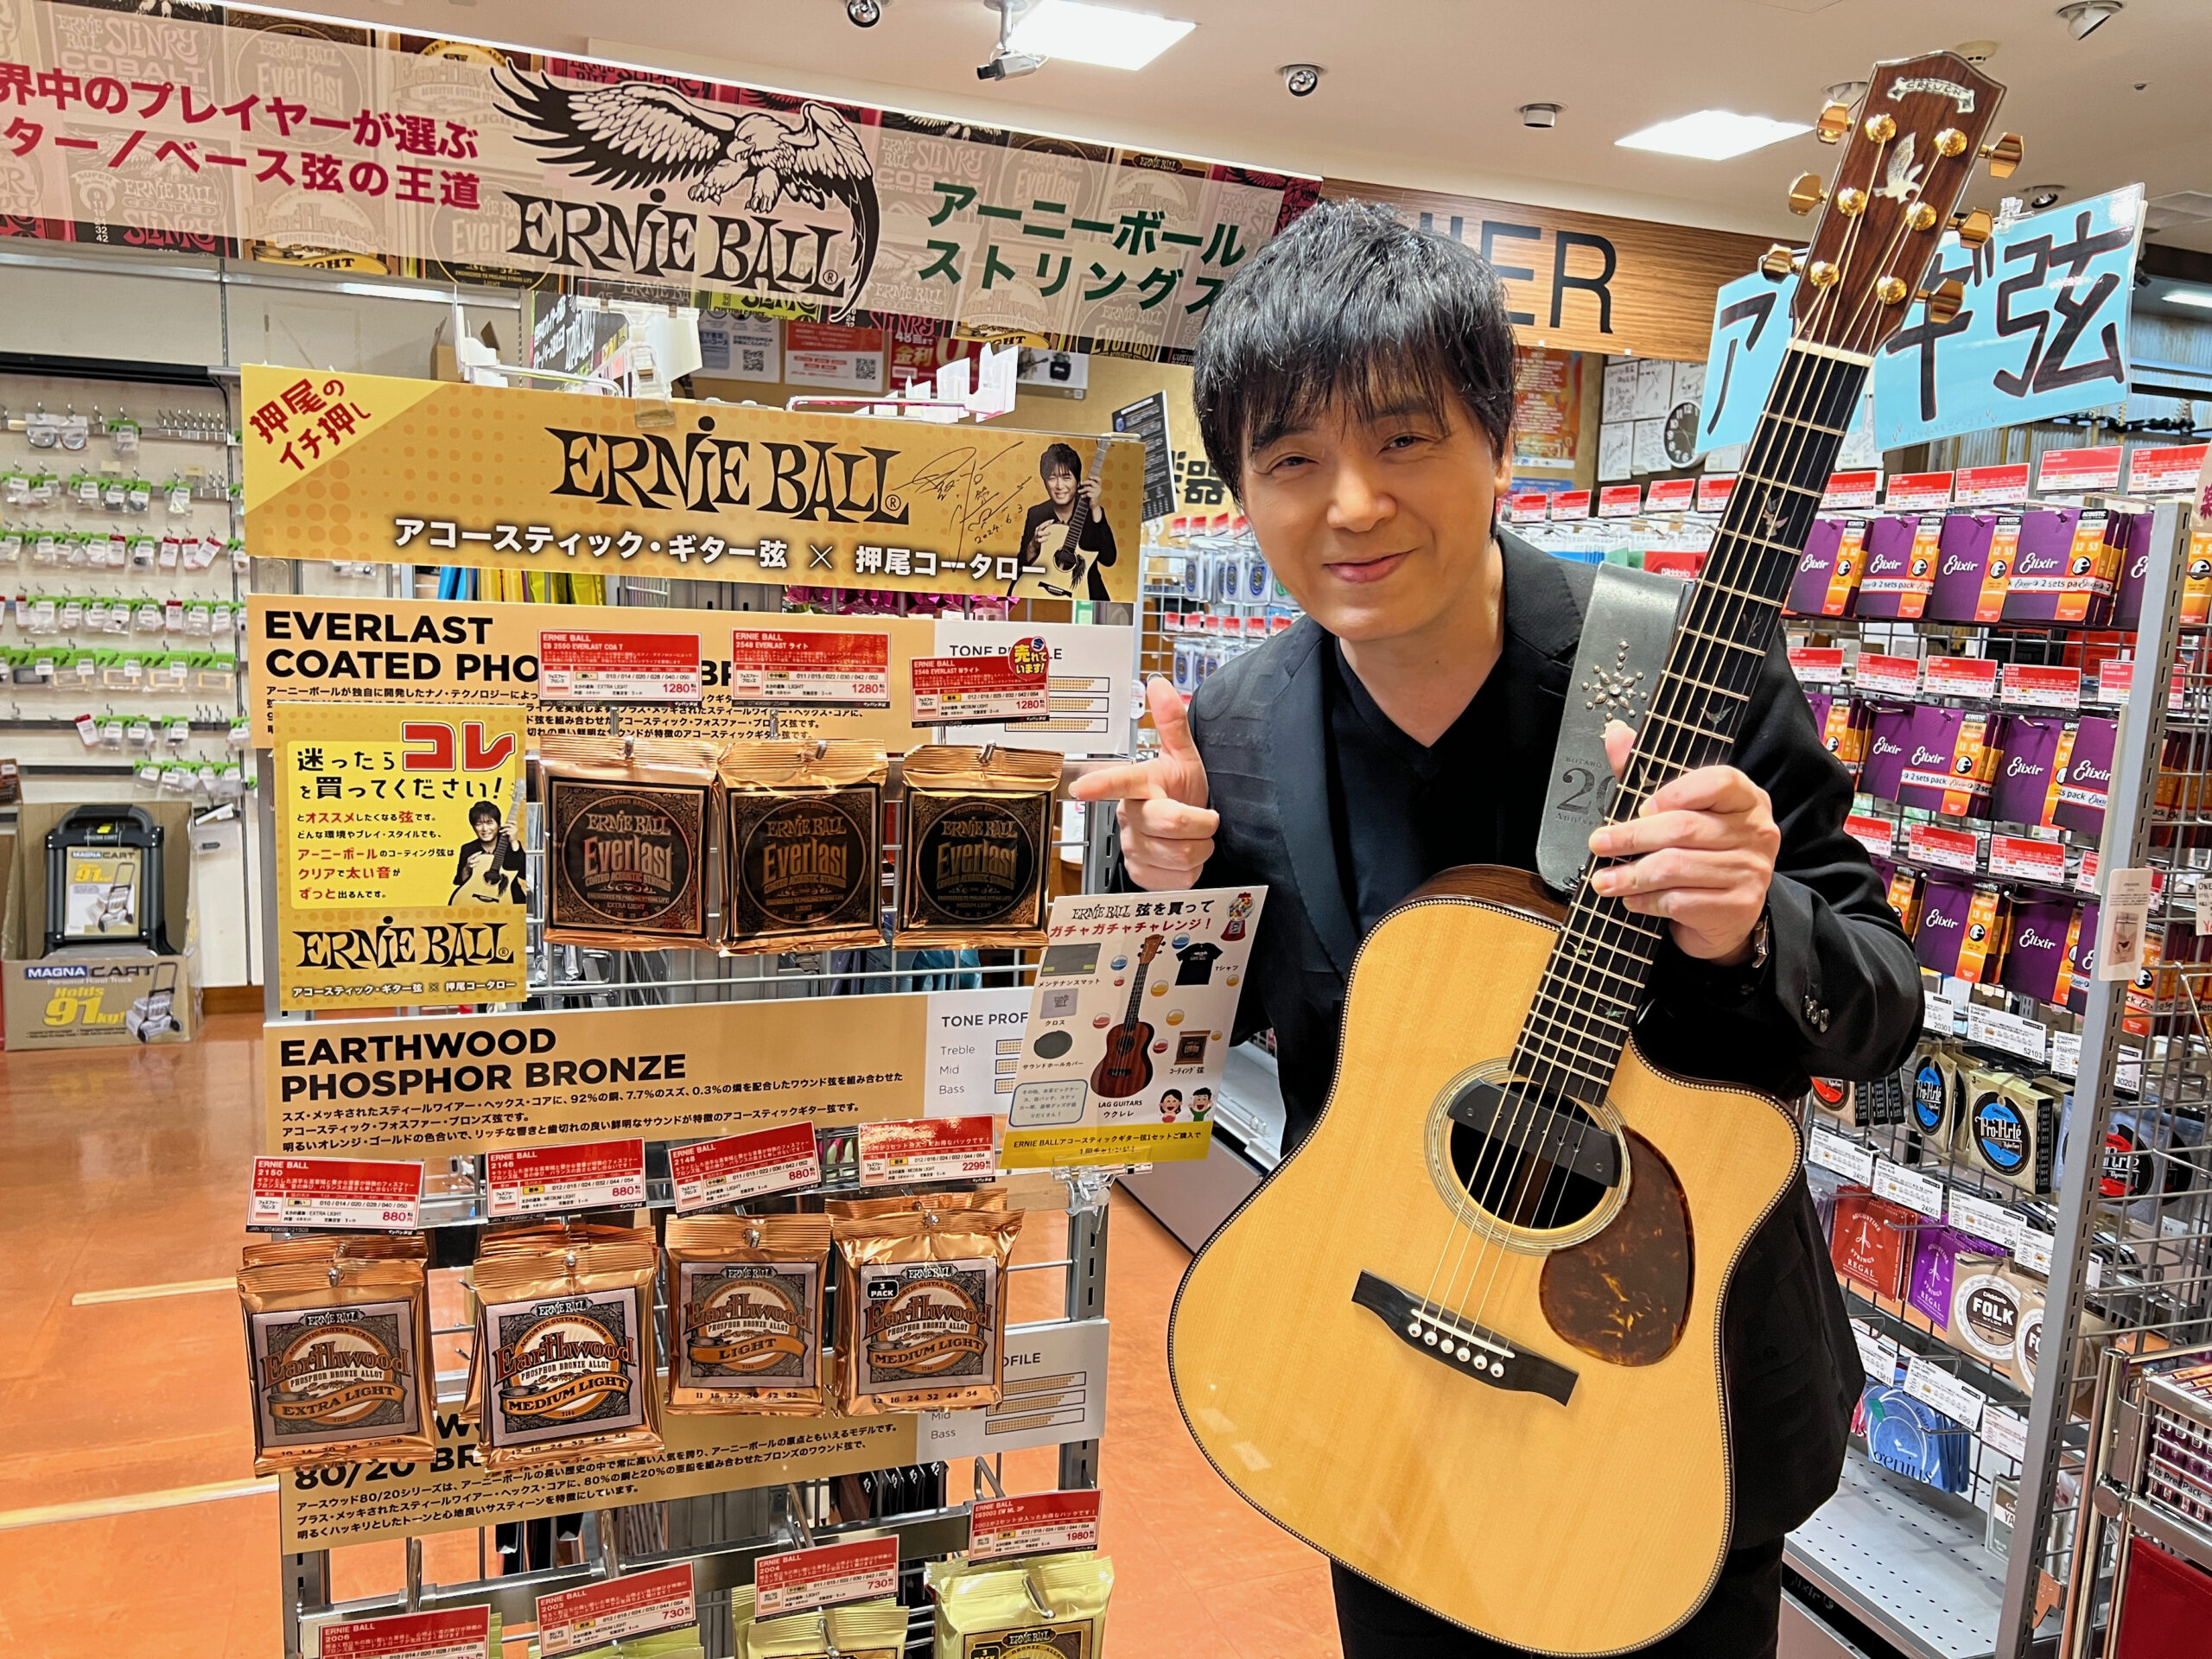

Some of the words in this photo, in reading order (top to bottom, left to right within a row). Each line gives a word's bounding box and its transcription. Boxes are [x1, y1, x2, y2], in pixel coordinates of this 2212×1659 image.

[66, 34, 102, 52] BALL
[60, 51, 205, 85] COBALT
[927, 181, 1247, 269] アーニーボール
[701, 215, 846, 298] BALL
[249, 378, 346, 445] 押尾の
[278, 400, 372, 472] イチ押し
[757, 440, 909, 524] BALL
[395, 518, 789, 569] アコースティック・ギター弦
[855, 546, 1047, 582] 押尾コータロー
[2075, 542, 2083, 551] 12
[1800, 553, 1829, 572] Elixir
[1870, 554, 1901, 574] Elixir
[1943, 555, 1979, 575] Elixir
[2019, 553, 2059, 574] Elixir
[265, 610, 493, 645] EVERLAST
[1014, 645, 1047, 663] 売れて
[265, 649, 442, 681] COATED
[663, 683, 690, 693] 1280
[852, 683, 879, 694] 1280
[1015, 700, 1039, 709] 1280
[1873, 736, 1902, 755] Elixir
[1911, 747, 1945, 766] Elixir
[2007, 757, 2044, 777] Elixir
[301, 776, 502, 799] を買ってください!
[1930, 776, 1947, 785] pack
[297, 810, 436, 824] とオススメしたくなる弦です。
[298, 847, 454, 861] アーニーボールのコーティング弦は
[583, 834, 674, 885] Everlast
[763, 837, 848, 887] Everlast
[937, 838, 1018, 882] Everlast
[298, 866, 400, 880] クリアで太い音が
[299, 887, 386, 900] ずっと出るんです。
[1135, 899, 1215, 917] 弦を買って
[1926, 909, 1959, 929] Elixir
[421, 923, 514, 968] BALL
[2019, 929, 2056, 950] Elixir
[26, 965, 87, 979] MAGNA
[89, 964, 155, 977] CART
[55, 987, 105, 997] Holds
[293, 982, 423, 997] アコースティック・ギター弦
[446, 982, 516, 993] 押尾コータロー
[1038, 978, 1101, 988] メンテナンスマット
[942, 1015, 983, 1028] TONE
[988, 1011, 1028, 1026] PROF
[281, 1027, 556, 1067] EARTHWOOD
[940, 1045, 976, 1056] Treble
[2024, 1047, 2039, 1058] 5210
[282, 1064, 512, 1103] PHOSPHOR
[525, 1053, 687, 1090] BRONZE
[940, 1064, 959, 1075] Mid
[939, 1084, 964, 1095] Bass
[2116, 1077, 2133, 1088] 3020
[490, 1153, 514, 1161] ERNIE
[517, 1151, 537, 1160] BALL
[673, 1147, 695, 1158] ERNIE
[697, 1144, 715, 1154] BALL
[789, 1169, 809, 1180] 880
[962, 1160, 985, 1171] 2299
[612, 1186, 633, 1197] 880
[382, 1211, 406, 1222] 880
[1847, 1259, 1875, 1278] REGAL
[1920, 1291, 1942, 1313] REGAL
[683, 1294, 812, 1335] Earthwood
[862, 1294, 993, 1341] Earthwood
[1973, 1298, 2016, 1326] FOLK
[719, 1338, 777, 1360] LIGHT
[874, 1345, 935, 1363] MEDIUM
[938, 1338, 982, 1351] LIGHT
[260, 1341, 411, 1392] Earthwood
[493, 1331, 637, 1388] Earthwood
[521, 1365, 556, 1381] PHOSPHOR
[559, 1361, 586, 1370] BRONZE
[283, 1397, 341, 1416] EXTRA
[345, 1385, 396, 1402] LIGHT
[508, 1386, 576, 1411] MEDIUM
[578, 1376, 627, 1393] LIGHT
[931, 1427, 956, 1440] Bass
[1066, 1531, 1089, 1541] 1980
[760, 1559, 780, 1567] ERNIE
[867, 1580, 888, 1590] 730
[541, 1596, 563, 1605] ERNIE
[566, 1590, 587, 1599] BALL
[662, 1608, 683, 1620] 730
